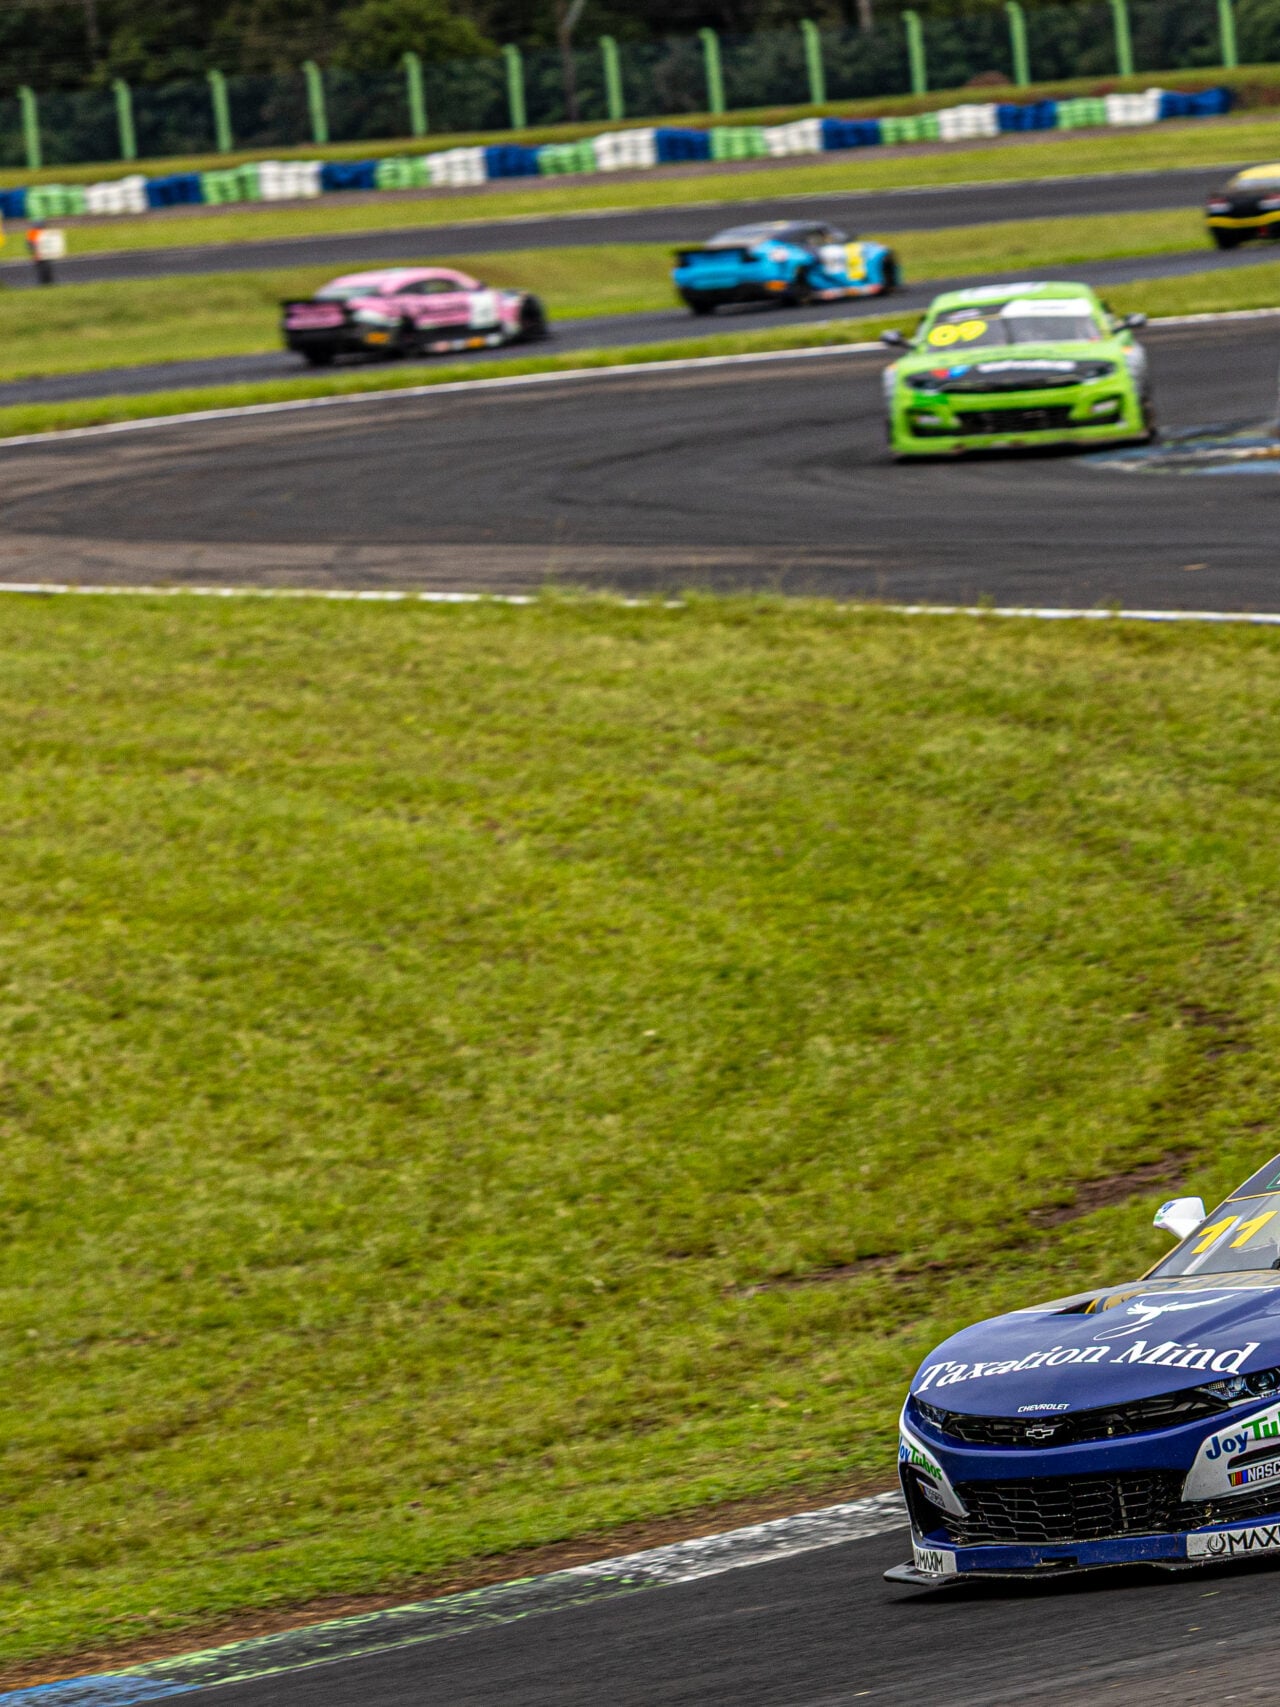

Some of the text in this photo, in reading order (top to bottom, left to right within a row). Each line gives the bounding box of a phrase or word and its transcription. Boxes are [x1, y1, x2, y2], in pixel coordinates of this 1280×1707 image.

[1191, 1211, 1278, 1254] 11
[914, 1341, 1260, 1395] Taxation Mind
[1017, 1402, 1070, 1413] CHEVROLET
[919, 1551, 944, 1572] MAXIM
